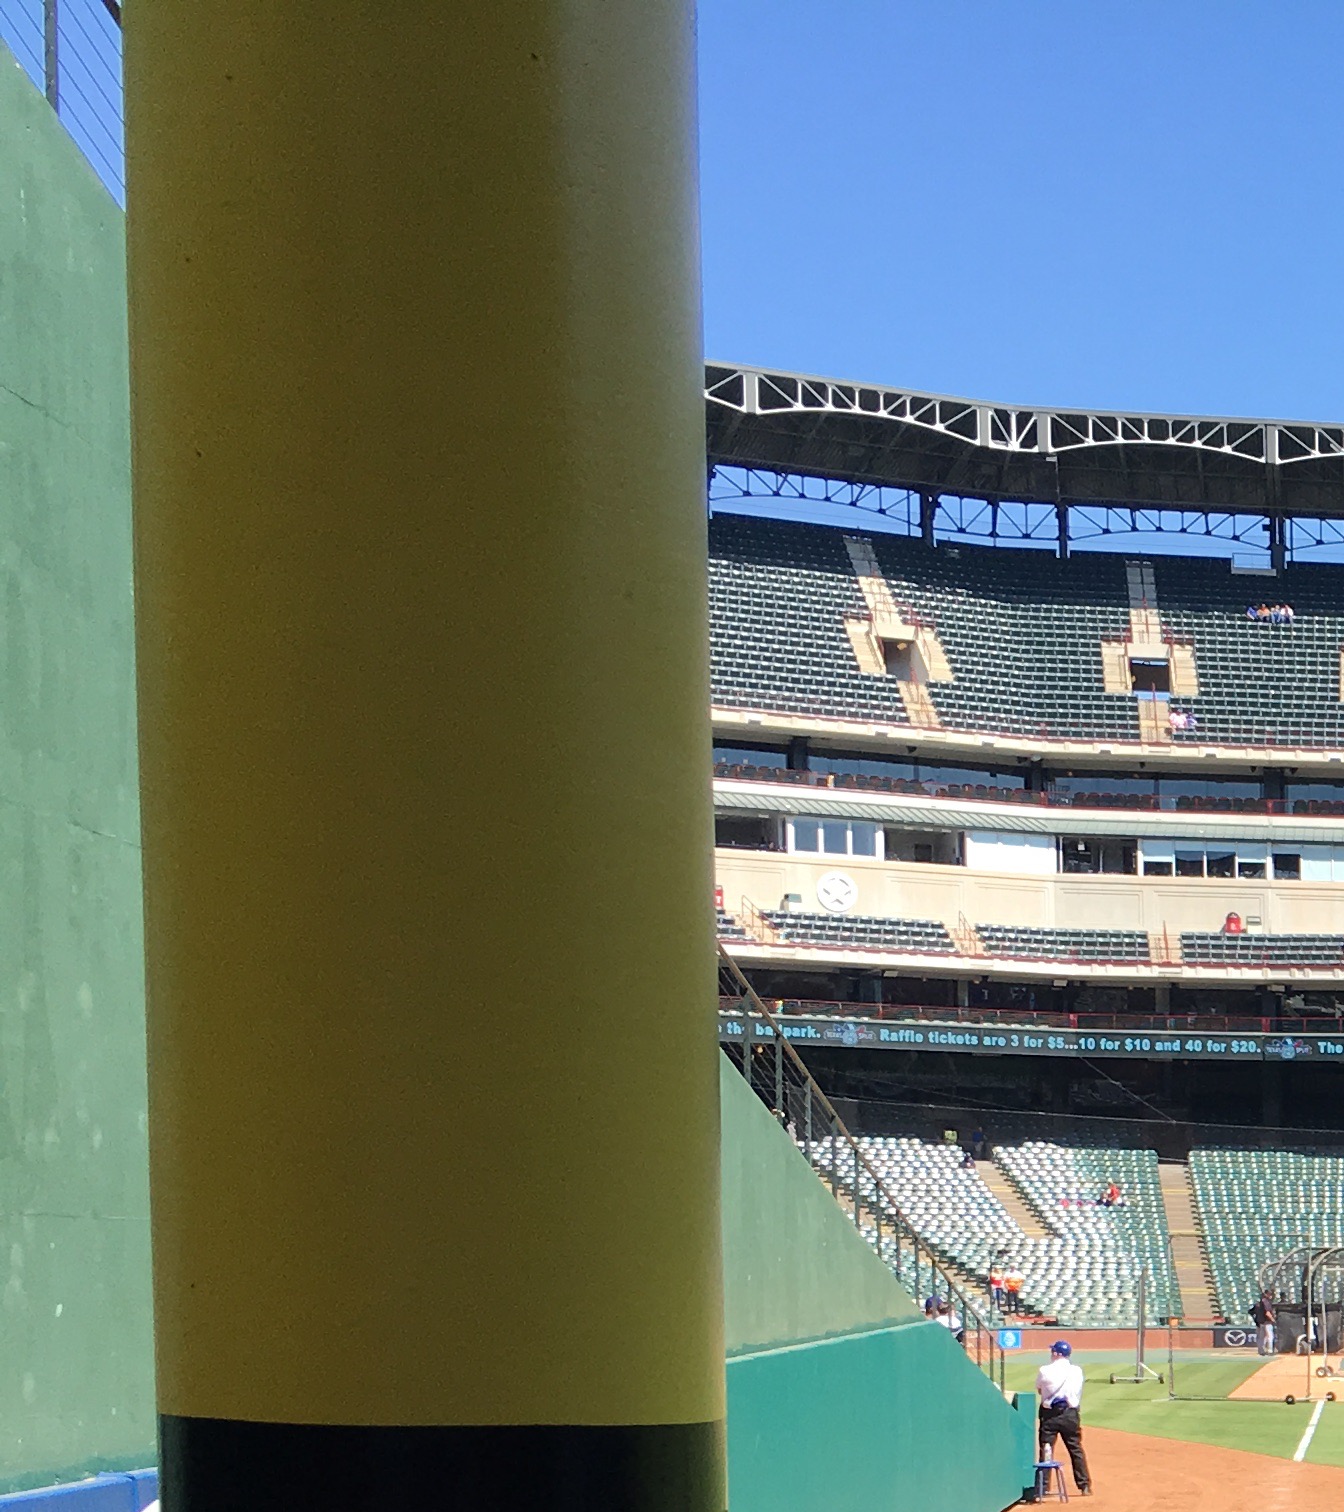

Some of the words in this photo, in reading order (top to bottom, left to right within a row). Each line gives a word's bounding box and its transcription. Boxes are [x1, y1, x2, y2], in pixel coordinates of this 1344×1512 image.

[755, 1022, 821, 1040] balpark.
[879, 1028, 924, 1043] Raffle
[927, 1031, 979, 1046] tickets
[982, 1035, 1007, 1047] are
[1010, 1034, 1020, 1047] 3
[1023, 1035, 1044, 1048] for
[1099, 1037, 1121, 1051] for
[1124, 1037, 1151, 1052] $10
[1154, 1039, 1181, 1052] and
[1184, 1039, 1203, 1052] 40
[1206, 1039, 1227, 1053] for
[1230, 1040, 1262, 1054] $20.
[1317, 1041, 1344, 1054] The
